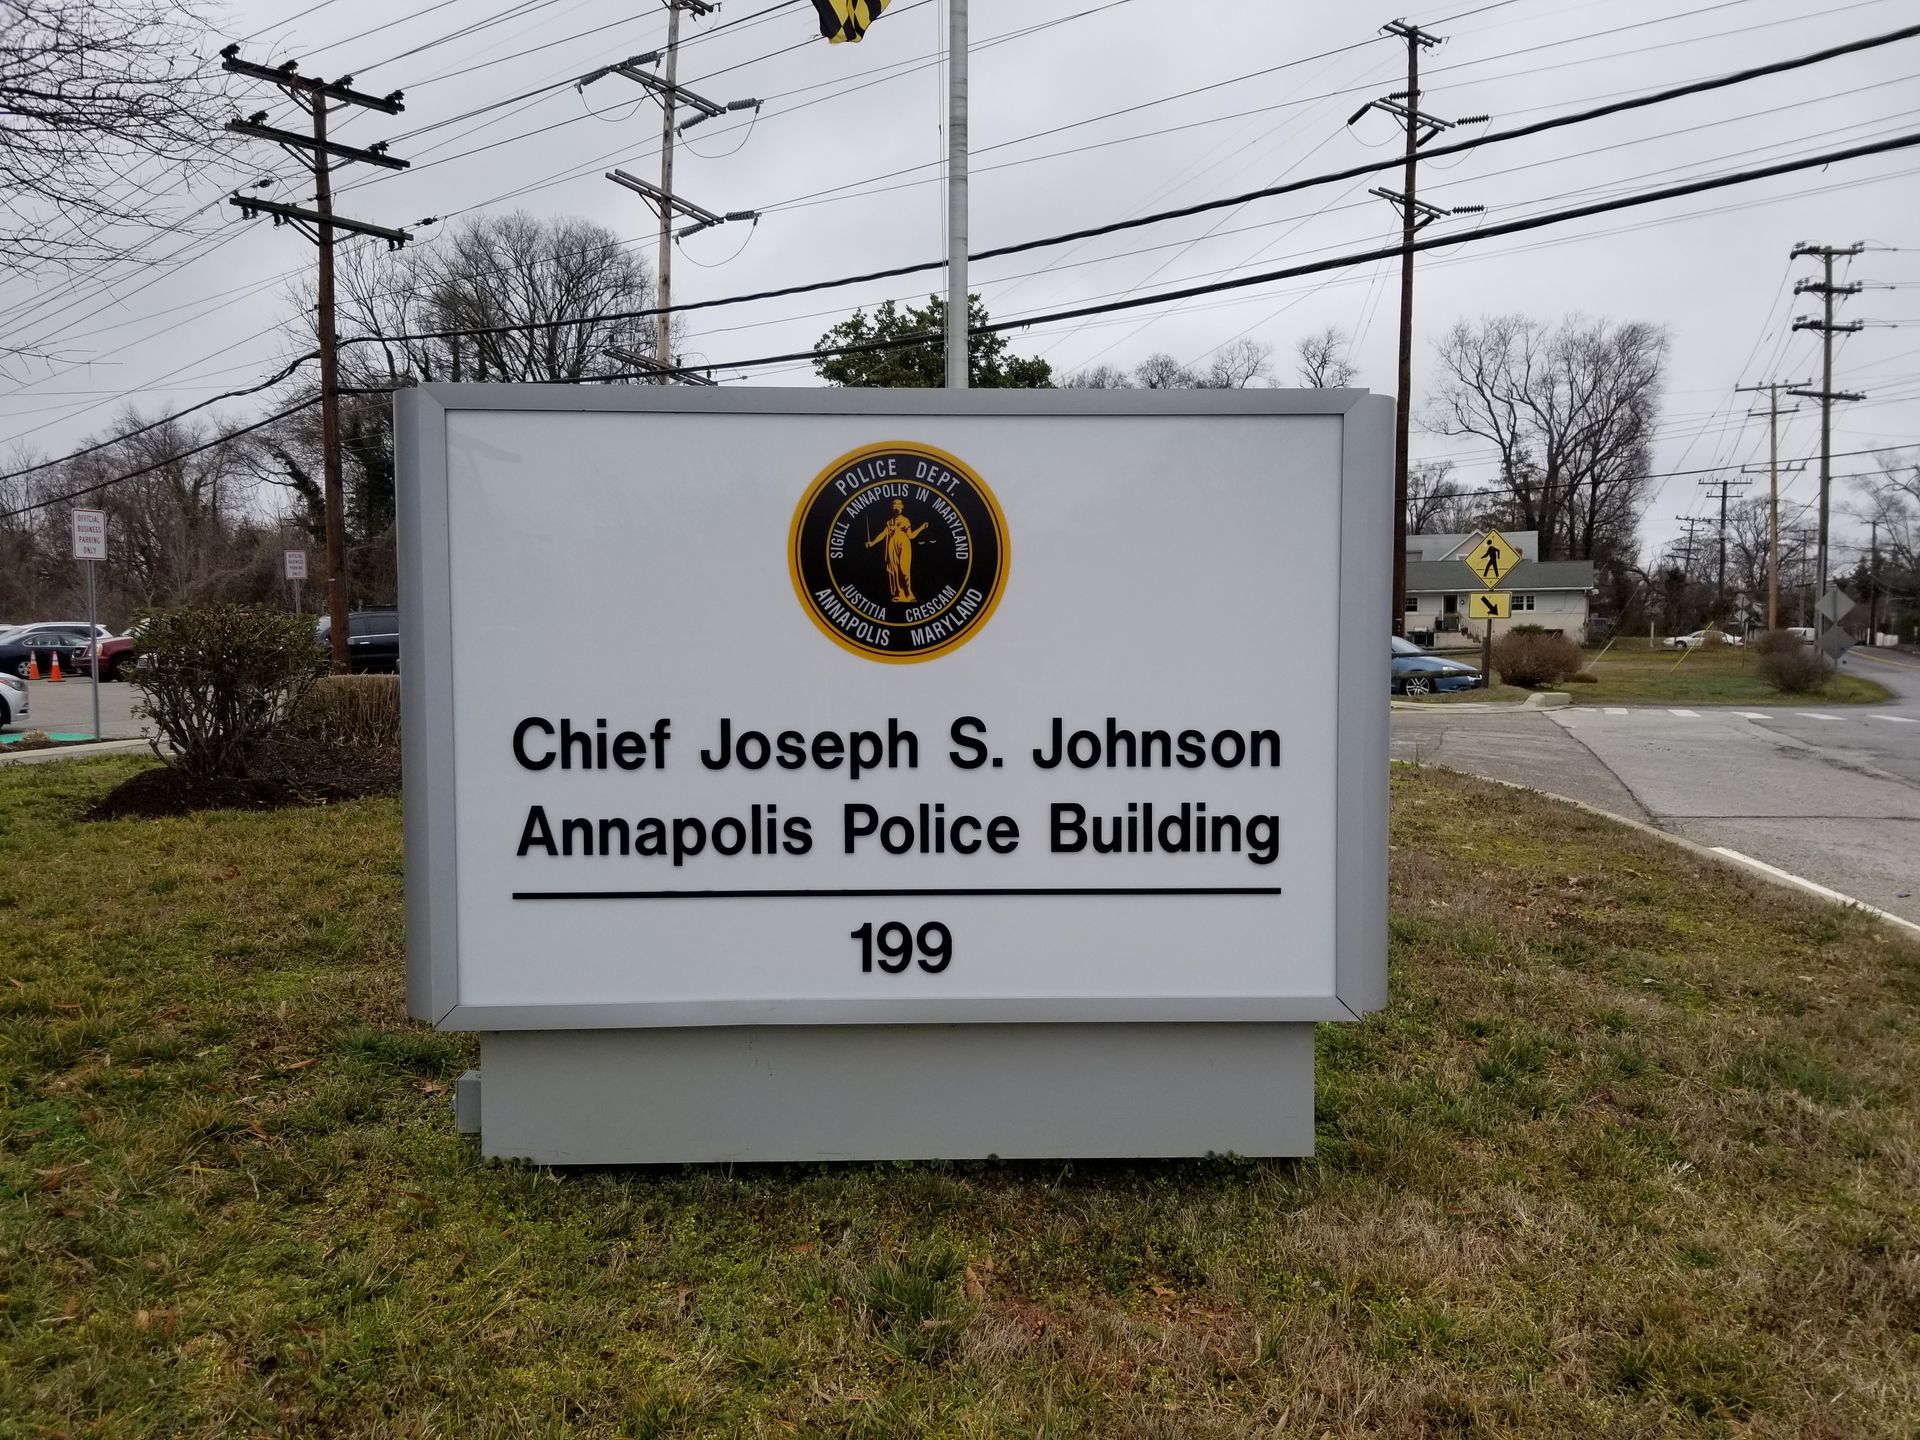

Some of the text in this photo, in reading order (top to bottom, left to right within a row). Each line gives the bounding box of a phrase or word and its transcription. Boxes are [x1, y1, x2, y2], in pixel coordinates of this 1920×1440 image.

[835, 459, 960, 497] POLICE DEPT.
[78, 514, 99, 523] OFFICIAL
[78, 525, 101, 533] BUSINESS
[830, 483, 968, 560] SIGILL ANNAPOLIS IN MARYLAND
[79, 536, 100, 544] PARKING
[84, 546, 96, 554] ONLY
[815, 588, 982, 646] ANNAPOLIS MARYLAND
[841, 583, 956, 622] JUSTITIA CRESCAM
[513, 716, 1280, 780] Chief Joseph S. Johnson
[517, 802, 1279, 866] Annapolis Police Building
[851, 921, 952, 974] 199
